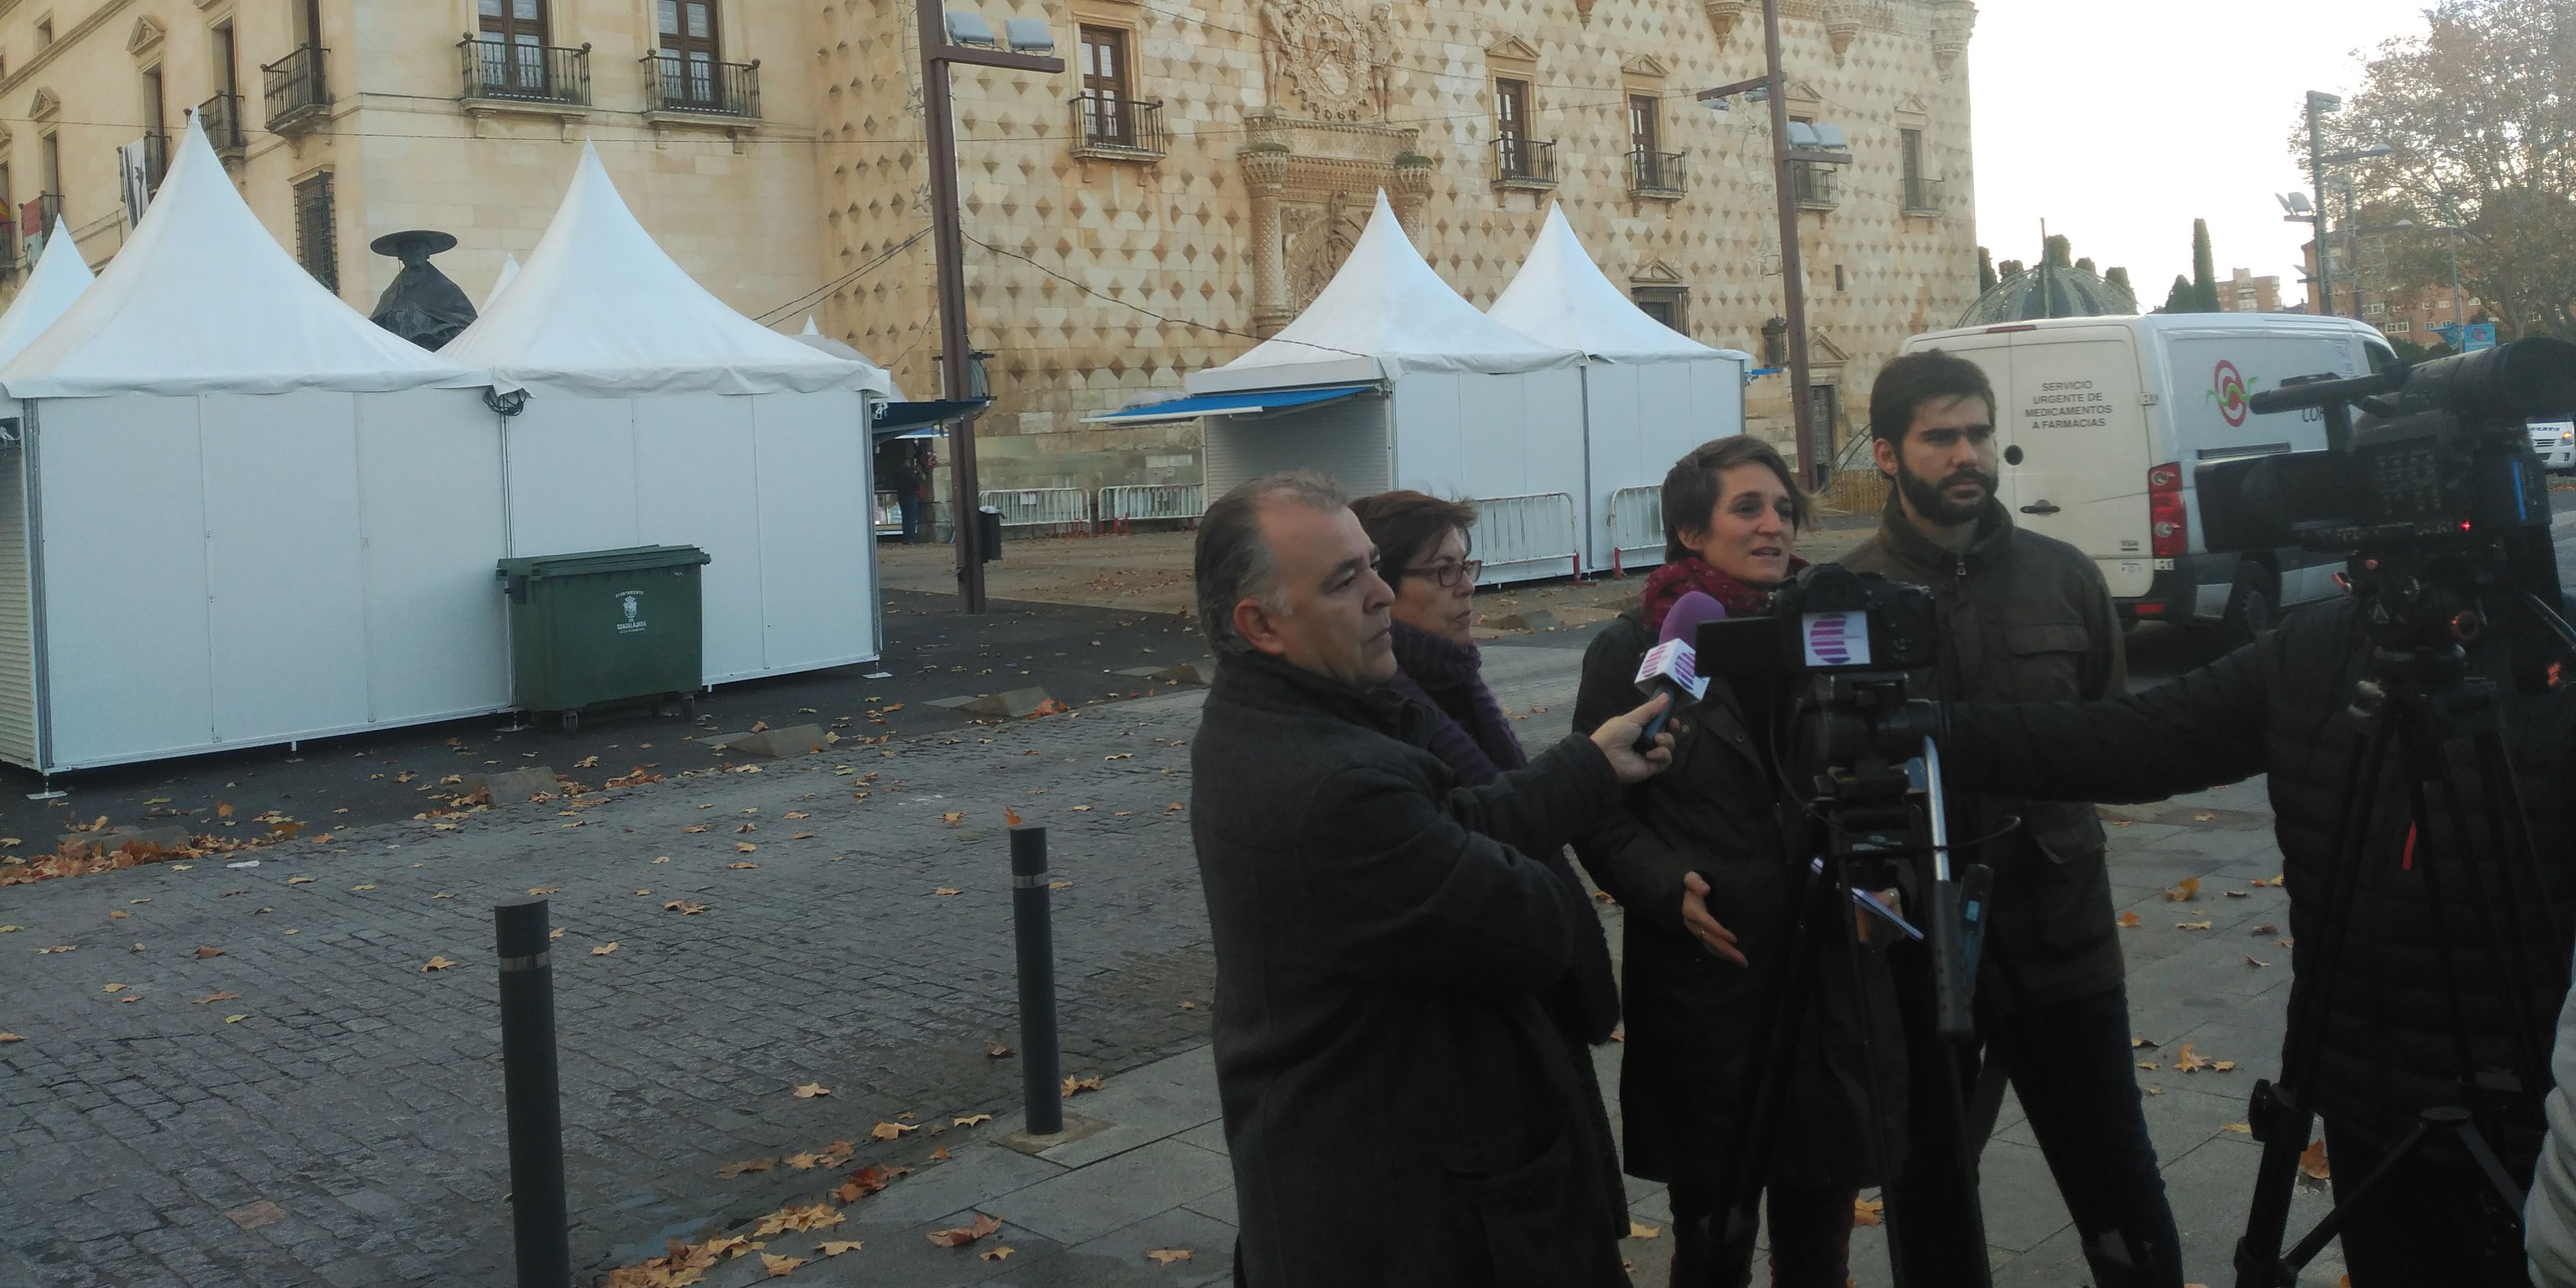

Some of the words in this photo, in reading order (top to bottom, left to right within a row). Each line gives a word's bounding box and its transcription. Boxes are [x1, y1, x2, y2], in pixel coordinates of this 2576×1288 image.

[2042, 380, 2093, 391] SERVICIO
[2034, 394, 2084, 404] URGENTE
[2087, 393, 2103, 401] DE
[2025, 405, 2113, 417] MEDICAMENTOS
[2042, 418, 2106, 429] FARMACIAS
[617, 621, 646, 630] GUADALAJARA
